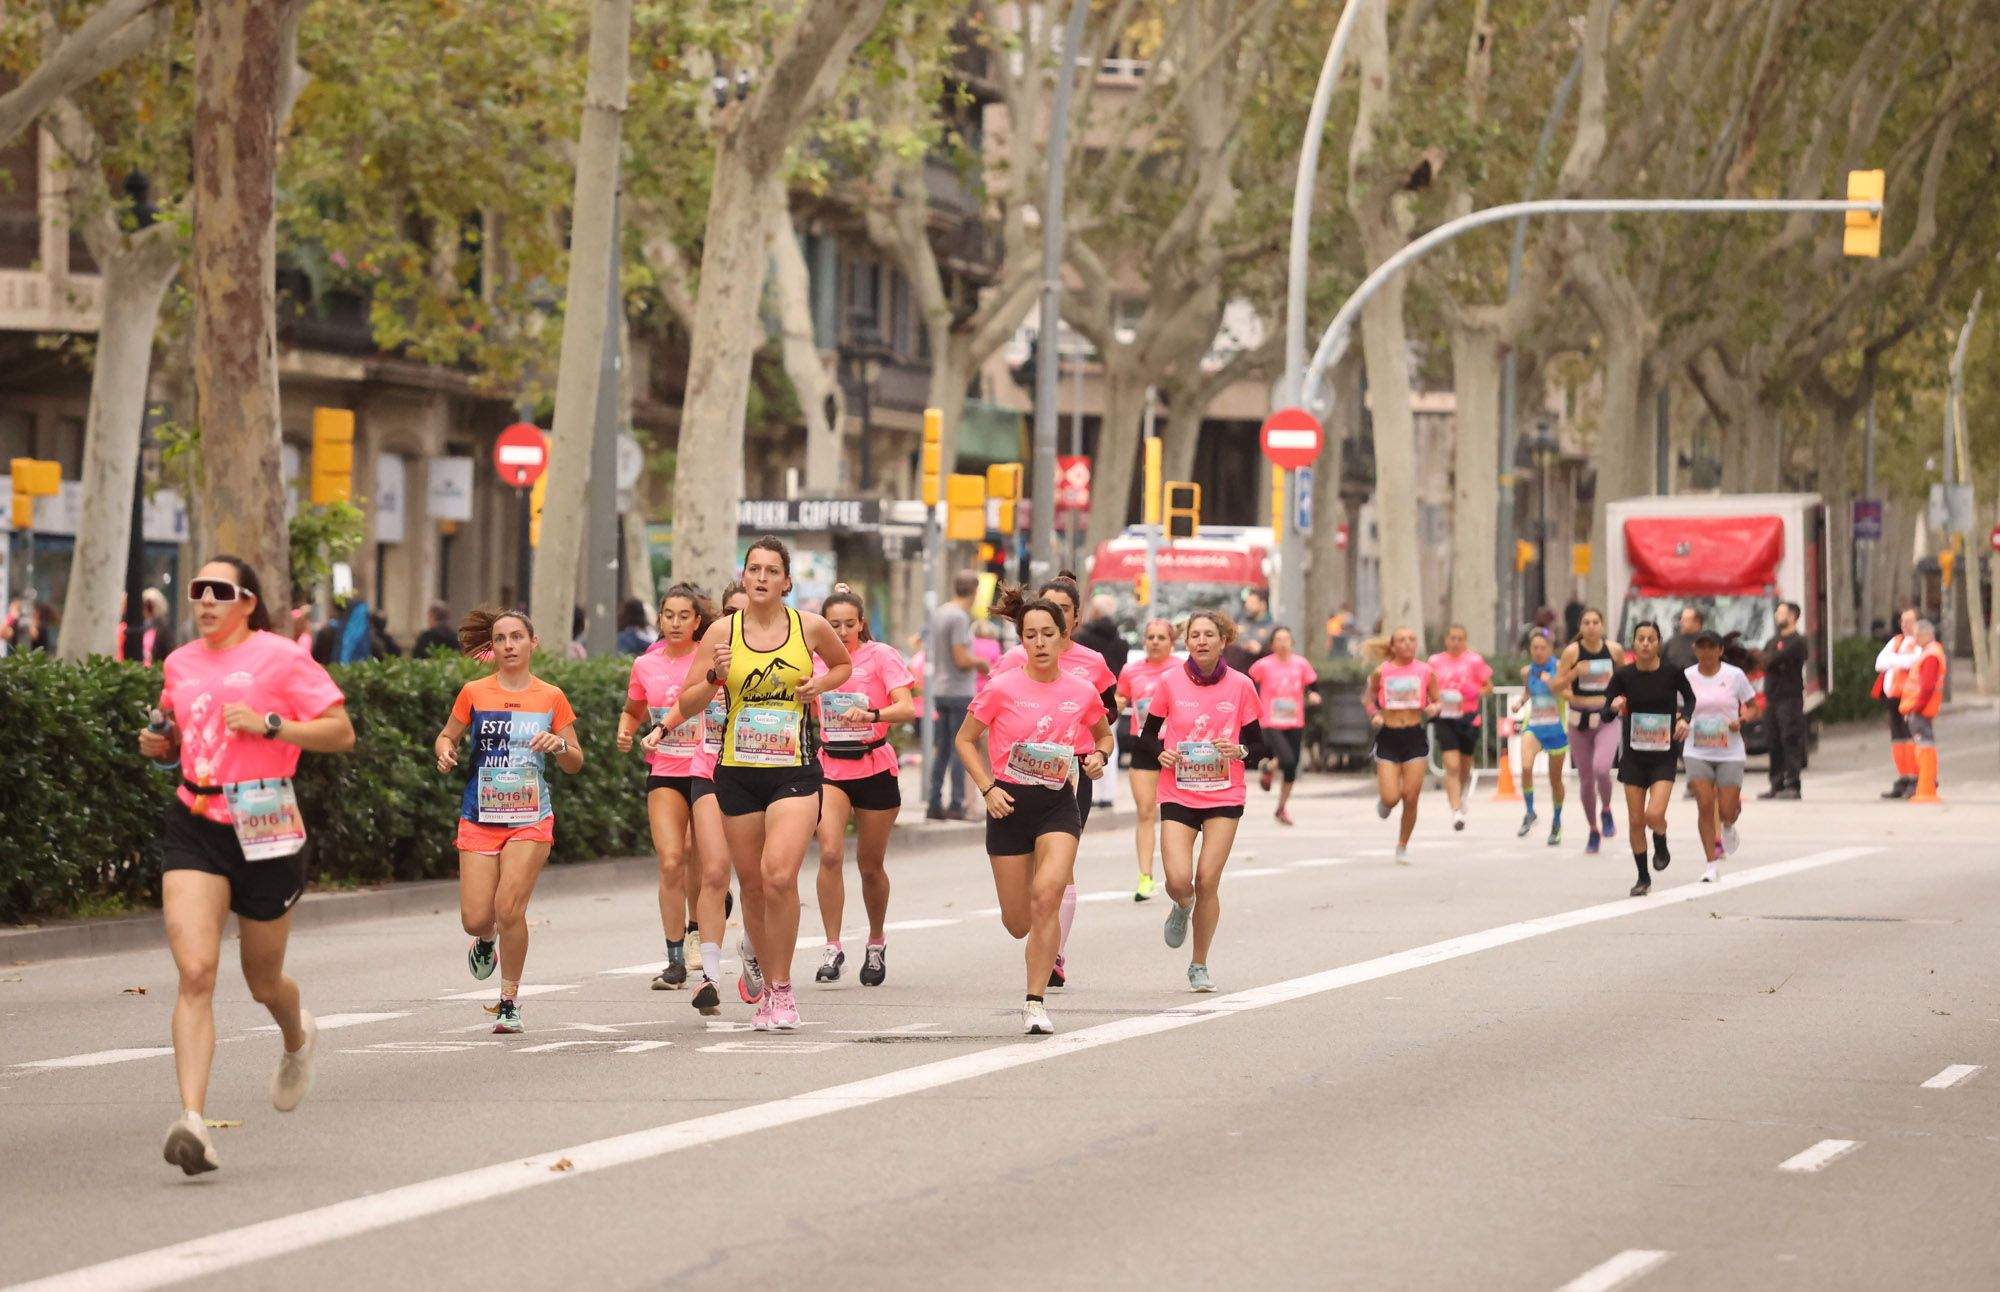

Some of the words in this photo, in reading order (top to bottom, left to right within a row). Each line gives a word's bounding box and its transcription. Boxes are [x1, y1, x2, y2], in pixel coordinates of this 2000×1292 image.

[800, 501, 861, 527] COFFEE
[480, 720, 512, 735] ESTO
[518, 721, 540, 735] NO
[480, 738, 494, 751] SE
[336, 1040, 850, 1054] BUS
